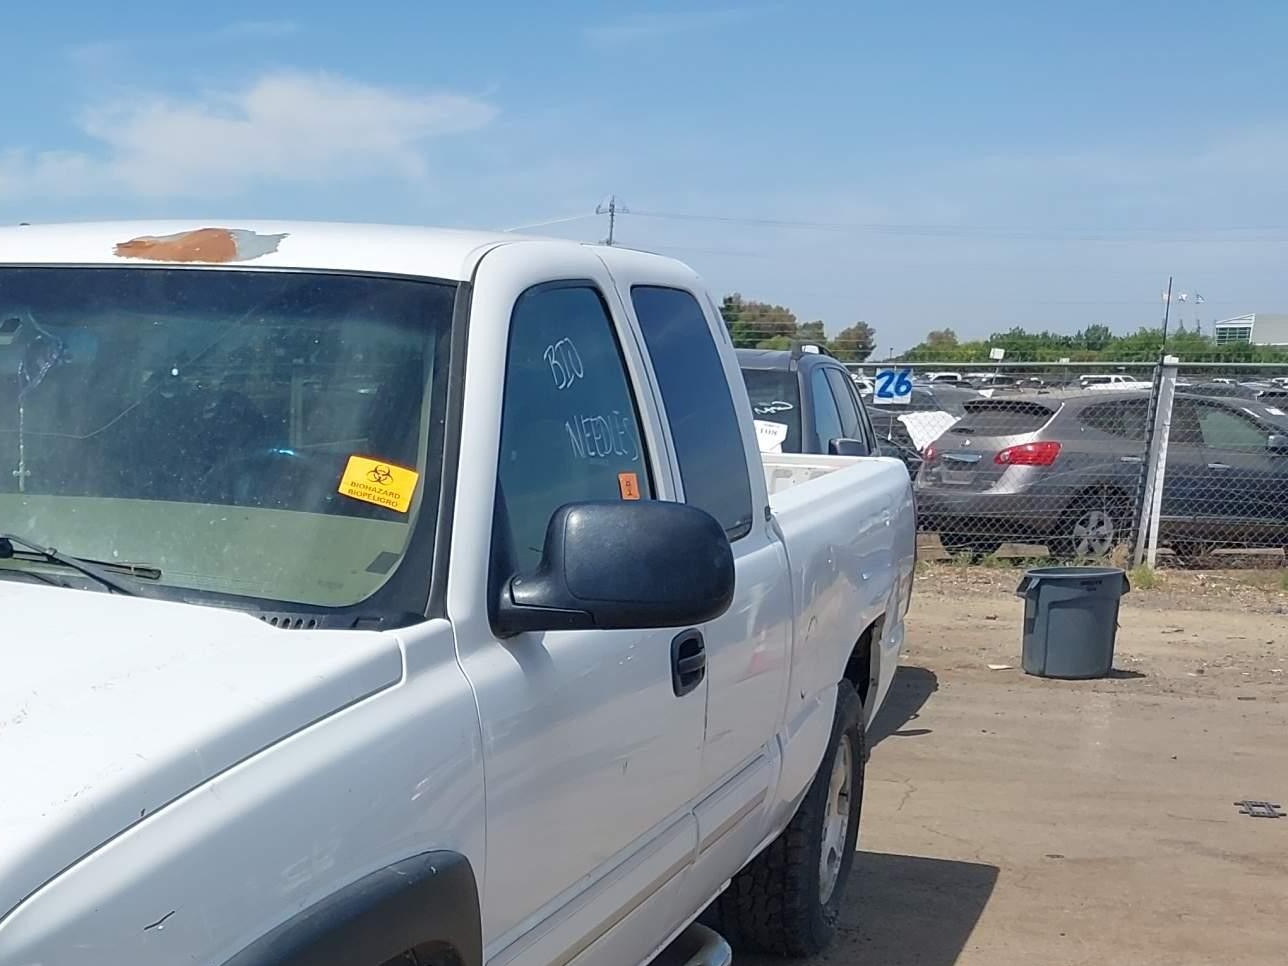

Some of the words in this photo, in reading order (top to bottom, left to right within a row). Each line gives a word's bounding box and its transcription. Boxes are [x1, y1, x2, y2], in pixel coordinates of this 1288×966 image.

[543, 337, 584, 390] BIO
[876, 366, 913, 398] 26
[564, 410, 639, 461] NEEDLES
[347, 488, 399, 508] BIOPELIGRO
[350, 481, 401, 500] BIOHAZARD
